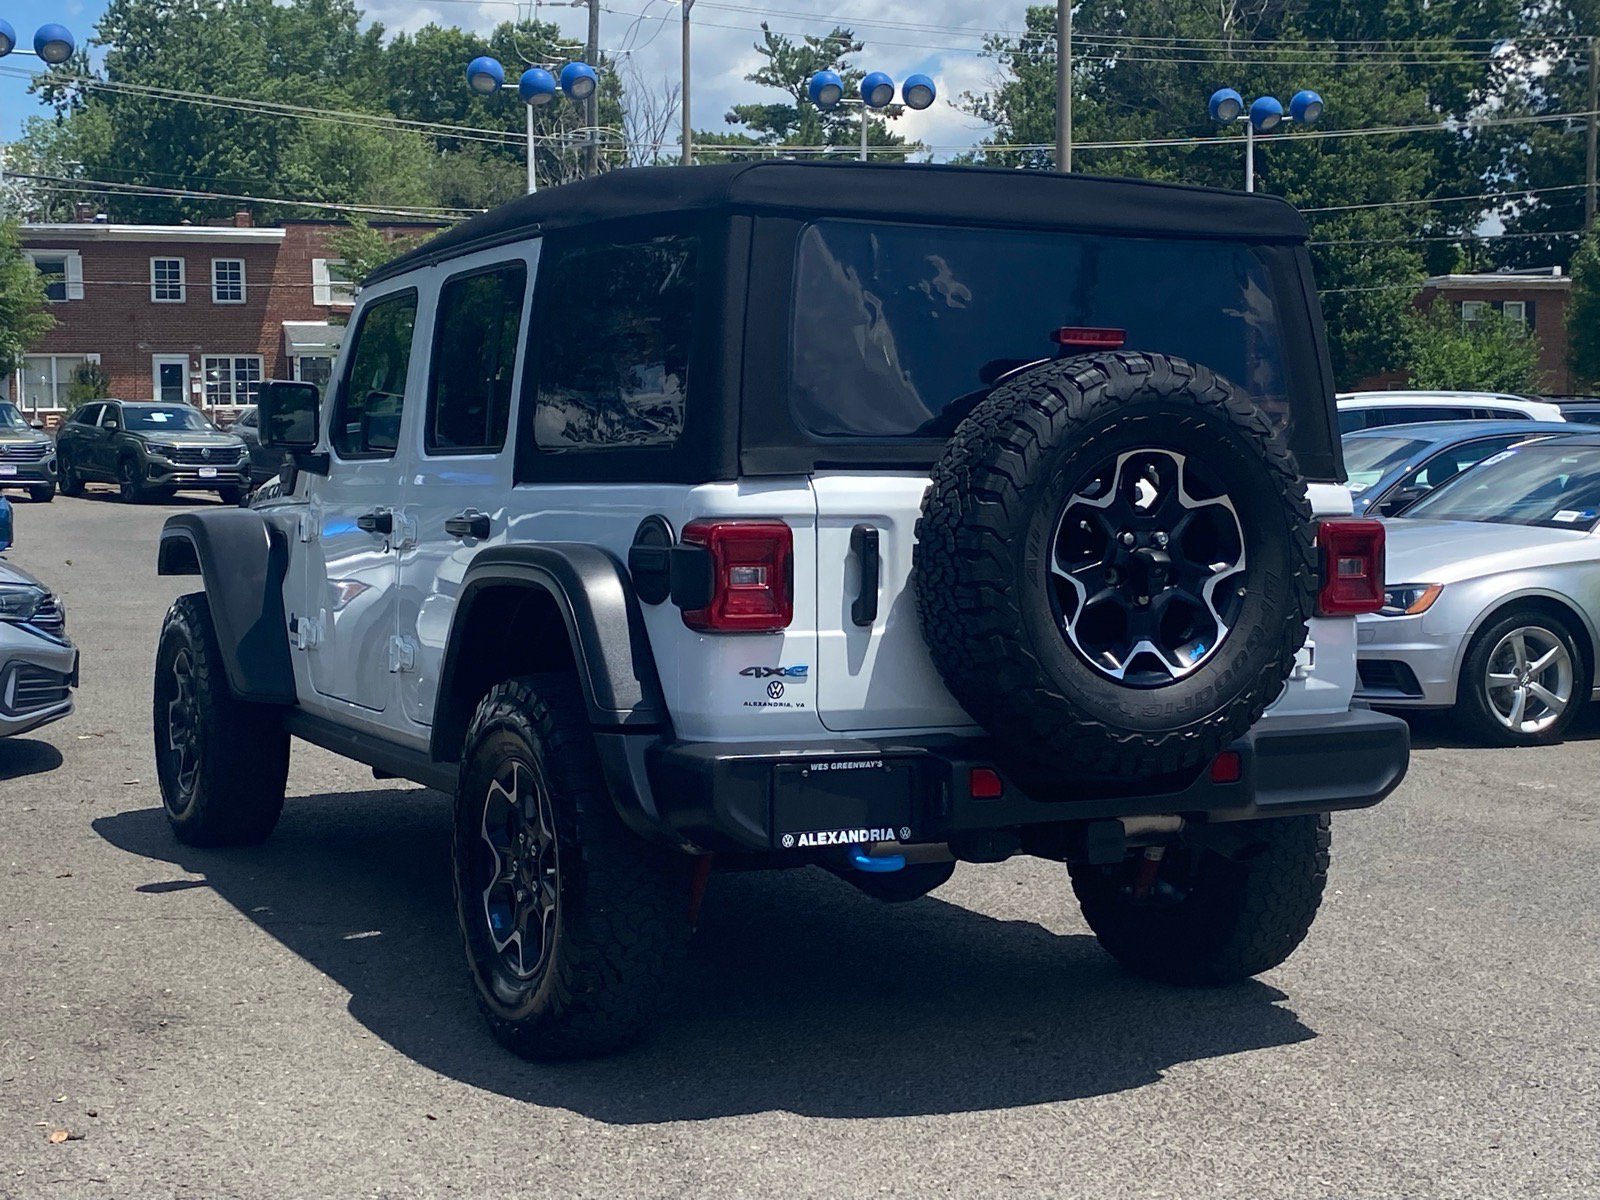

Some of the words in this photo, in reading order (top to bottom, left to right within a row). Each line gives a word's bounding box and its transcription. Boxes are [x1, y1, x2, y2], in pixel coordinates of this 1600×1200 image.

[810, 763, 829, 771] WES
[830, 760, 883, 770] GREENWAY'S
[798, 828, 896, 847] ALEXANDRIA
